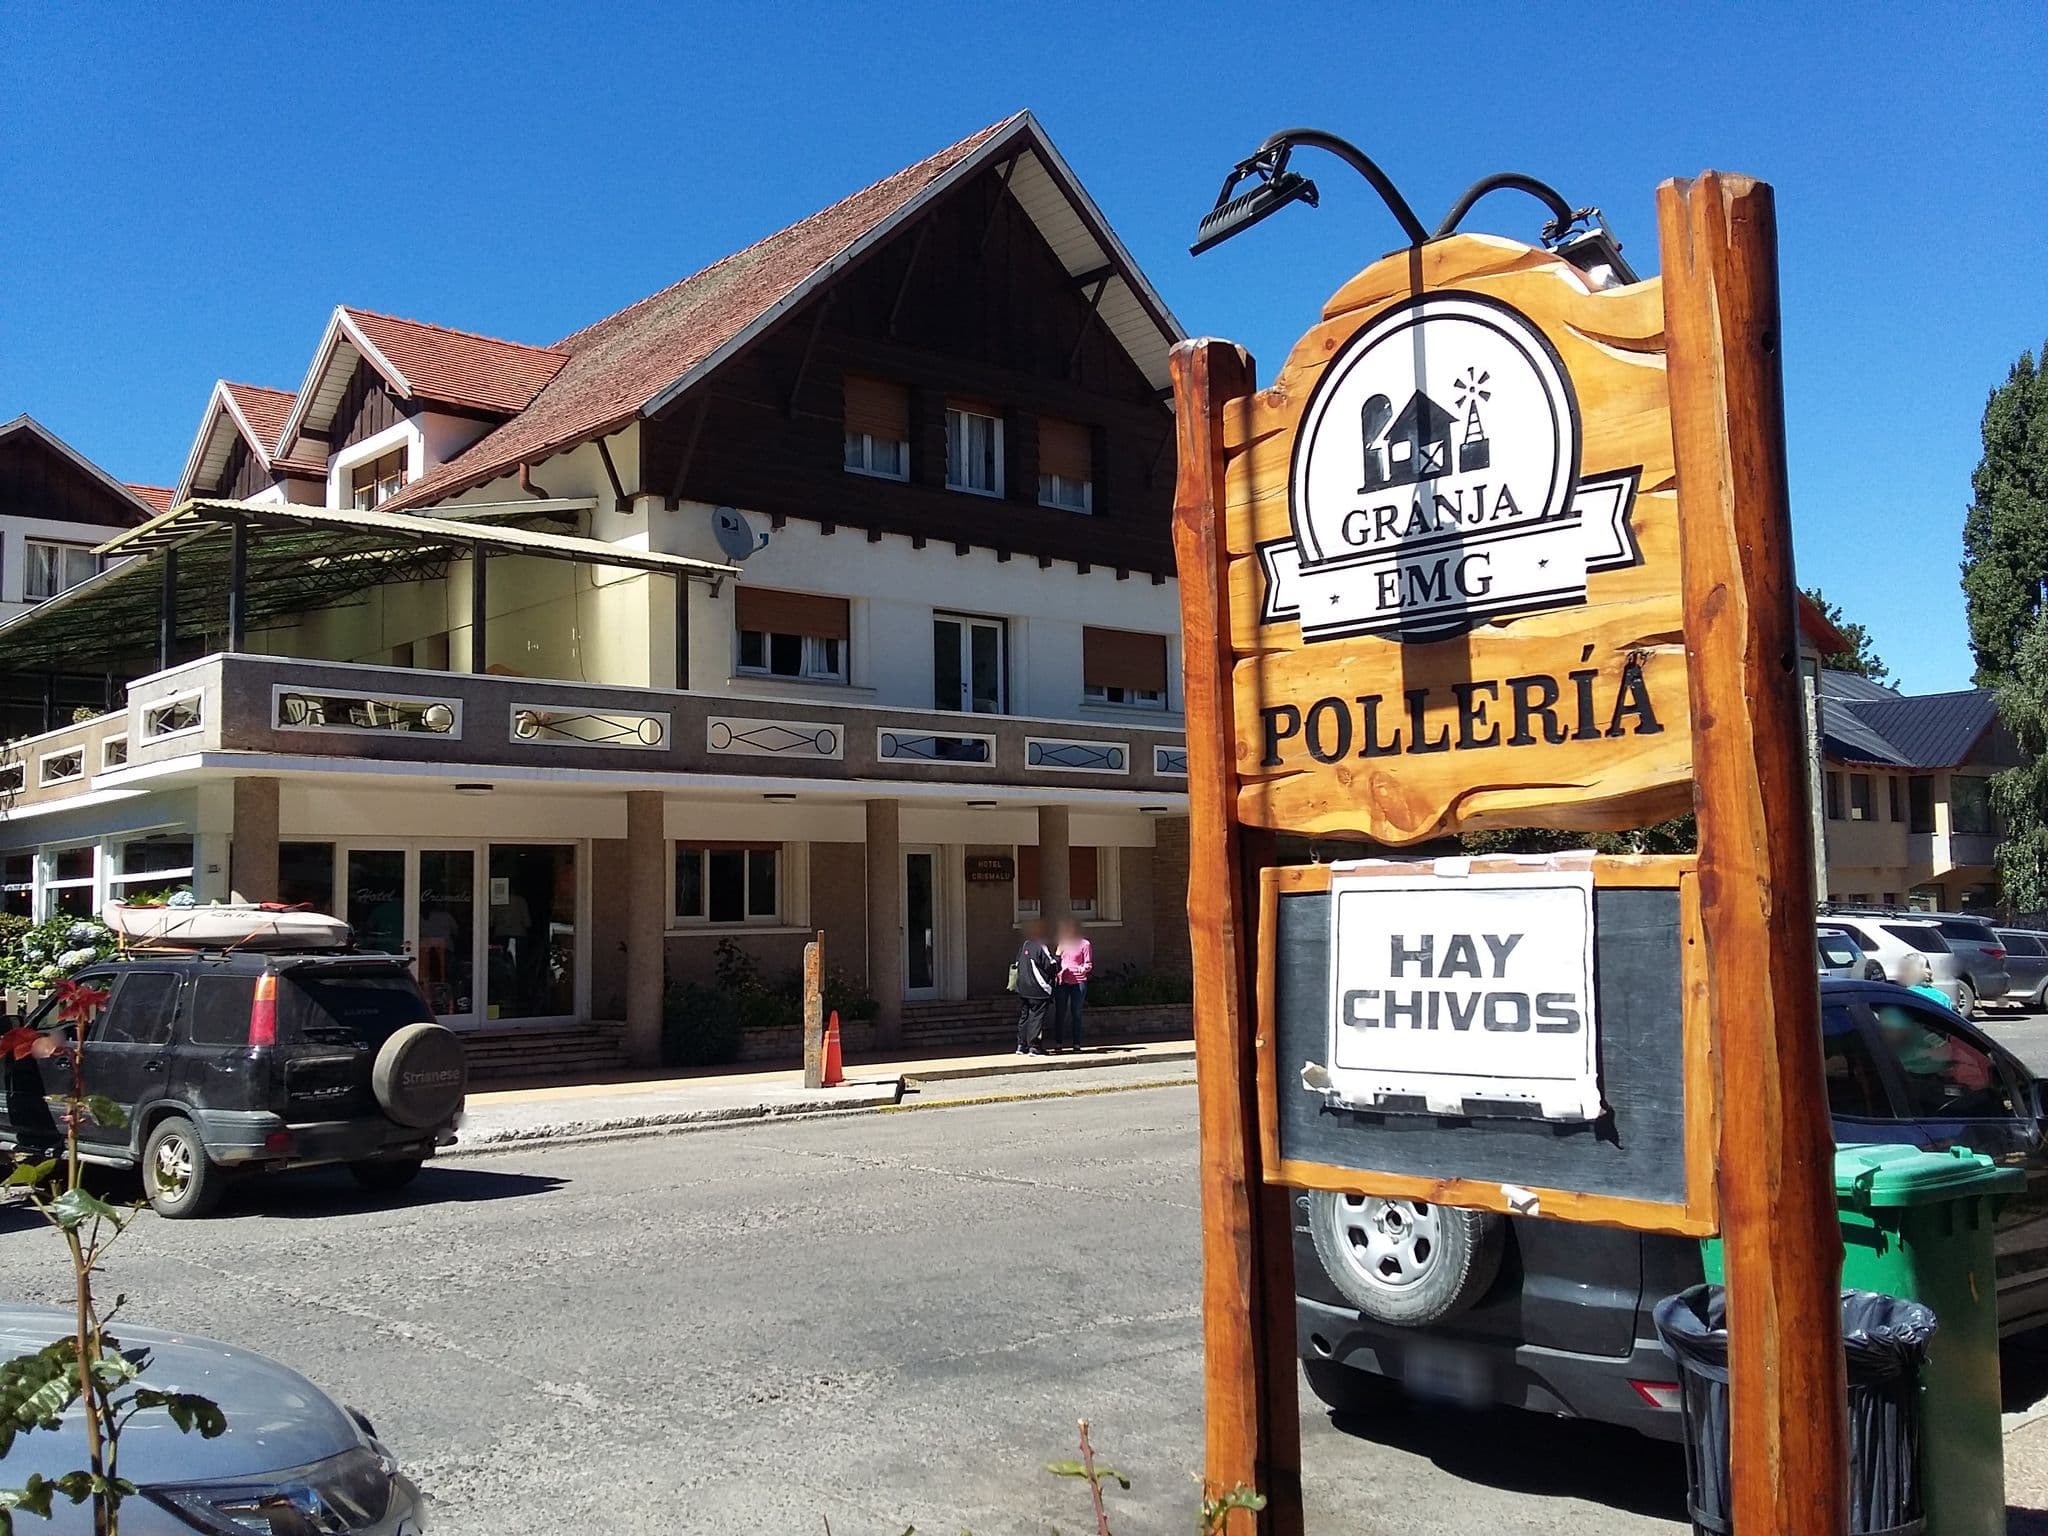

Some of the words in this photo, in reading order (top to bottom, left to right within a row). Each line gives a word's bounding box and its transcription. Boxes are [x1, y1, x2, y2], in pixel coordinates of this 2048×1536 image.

[1341, 483, 1524, 546] GRANJA
[1373, 552, 1494, 612] EMG
[1260, 644, 1664, 767] POLLERÍA
[978, 860, 1002, 868] HOTEL
[1390, 933, 1525, 979] HAY
[1343, 989, 1581, 1034] CHIVOS
